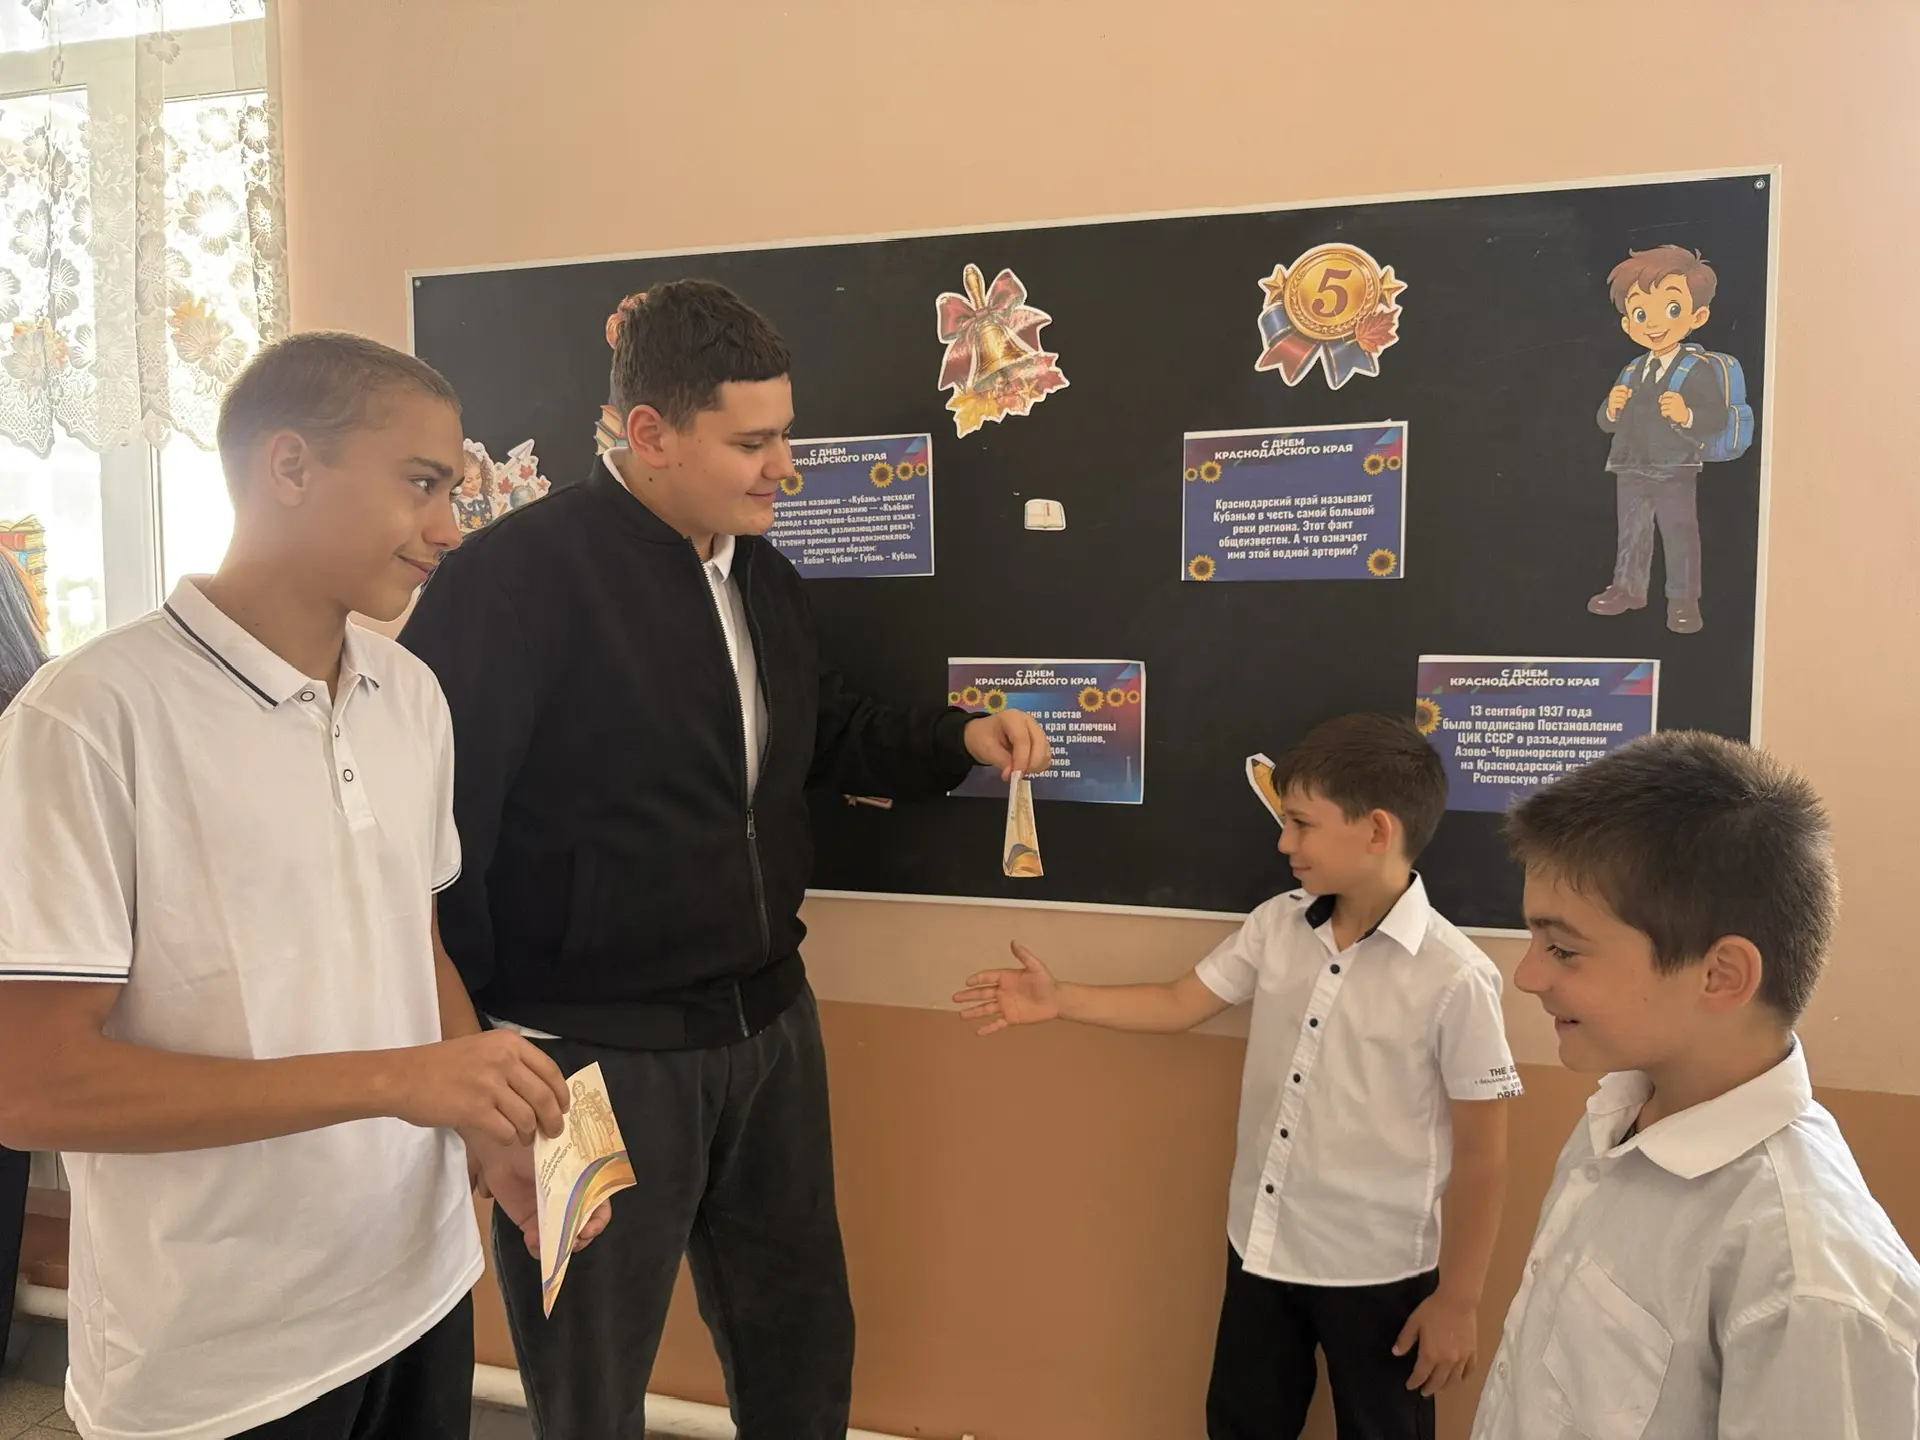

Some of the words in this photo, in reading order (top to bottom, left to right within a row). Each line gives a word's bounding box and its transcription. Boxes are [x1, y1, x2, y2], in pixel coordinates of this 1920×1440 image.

[1311, 267, 1352, 318] 5
[1261, 440, 1269, 449] С
[1271, 438, 1305, 449] ДНЕМ
[810, 449, 817, 457] С
[818, 447, 846, 457] ДНЕМ
[1214, 445, 1320, 460] КРАСНОДАРСКОГО
[1322, 444, 1353, 454] КРАЯ
[792, 455, 860, 466] СНОДАРСКОГО
[861, 452, 887, 462] КРАЯ
[808, 498, 841, 506] название
[882, 493, 916, 502] восходит
[1215, 495, 1292, 511] Краснодарский
[1294, 493, 1318, 507] край
[1320, 493, 1373, 505] называют
[833, 506, 868, 514] названию
[1213, 511, 1256, 524] Кубанью
[1258, 510, 1265, 520] в
[1267, 509, 1294, 520] честь
[1297, 506, 1327, 518] самой
[1329, 505, 1375, 517] большой
[831, 524, 888, 535] разливающаяся
[1232, 523, 1256, 536] реки
[1258, 521, 1300, 534] региона.
[1302, 519, 1325, 531] Этот
[1327, 519, 1353, 531] факт
[778, 539, 806, 547] течение
[807, 537, 837, 546] времени
[1218, 535, 1291, 548] общеизвестен.
[1293, 533, 1300, 544] А
[1302, 534, 1320, 543] что
[1322, 532, 1368, 543] означает
[803, 547, 846, 555] следующим
[891, 551, 917, 561] Кубань
[1227, 549, 1246, 560] имя
[1248, 546, 1270, 559] этой
[1272, 545, 1310, 559] водной
[1311, 544, 1359, 559] артерии?
[1016, 669, 1023, 678] С
[1025, 669, 1055, 679] ДНЕМ
[1501, 669, 1510, 678] С
[1512, 668, 1548, 679] ДНЕМ
[975, 677, 1069, 687] КРАСНОДАРСКОГО
[1070, 677, 1097, 686] КРАЯ
[1450, 677, 1566, 688] КРАСНОДАРСКОГО
[1567, 677, 1600, 687] КРАЯ
[1044, 710, 1050, 719] в
[1052, 711, 1082, 719] состав
[1470, 705, 1481, 717] 13
[1484, 705, 1536, 719] сентября
[1538, 705, 1564, 717] 1937
[1566, 707, 1592, 719] года
[1045, 723, 1067, 733] края
[1068, 722, 1117, 732] включены
[1442, 717, 1472, 730] было
[1475, 720, 1535, 733] подписано
[1537, 719, 1623, 732] Постановление
[1066, 733, 1106, 744] районов,
[1457, 732, 1482, 745] ЦИК
[1484, 732, 1515, 744] СССР
[1517, 735, 1524, 744] о
[1526, 735, 1607, 747] разъединении
[1454, 745, 1576, 760] Азово-Черноморского
[1460, 761, 1474, 770] на
[1476, 760, 1563, 773] Краснодарский
[1061, 770, 1081, 778] типа
[1473, 774, 1538, 786] Ростовскую
[1489, 1067, 1507, 1077] THE
